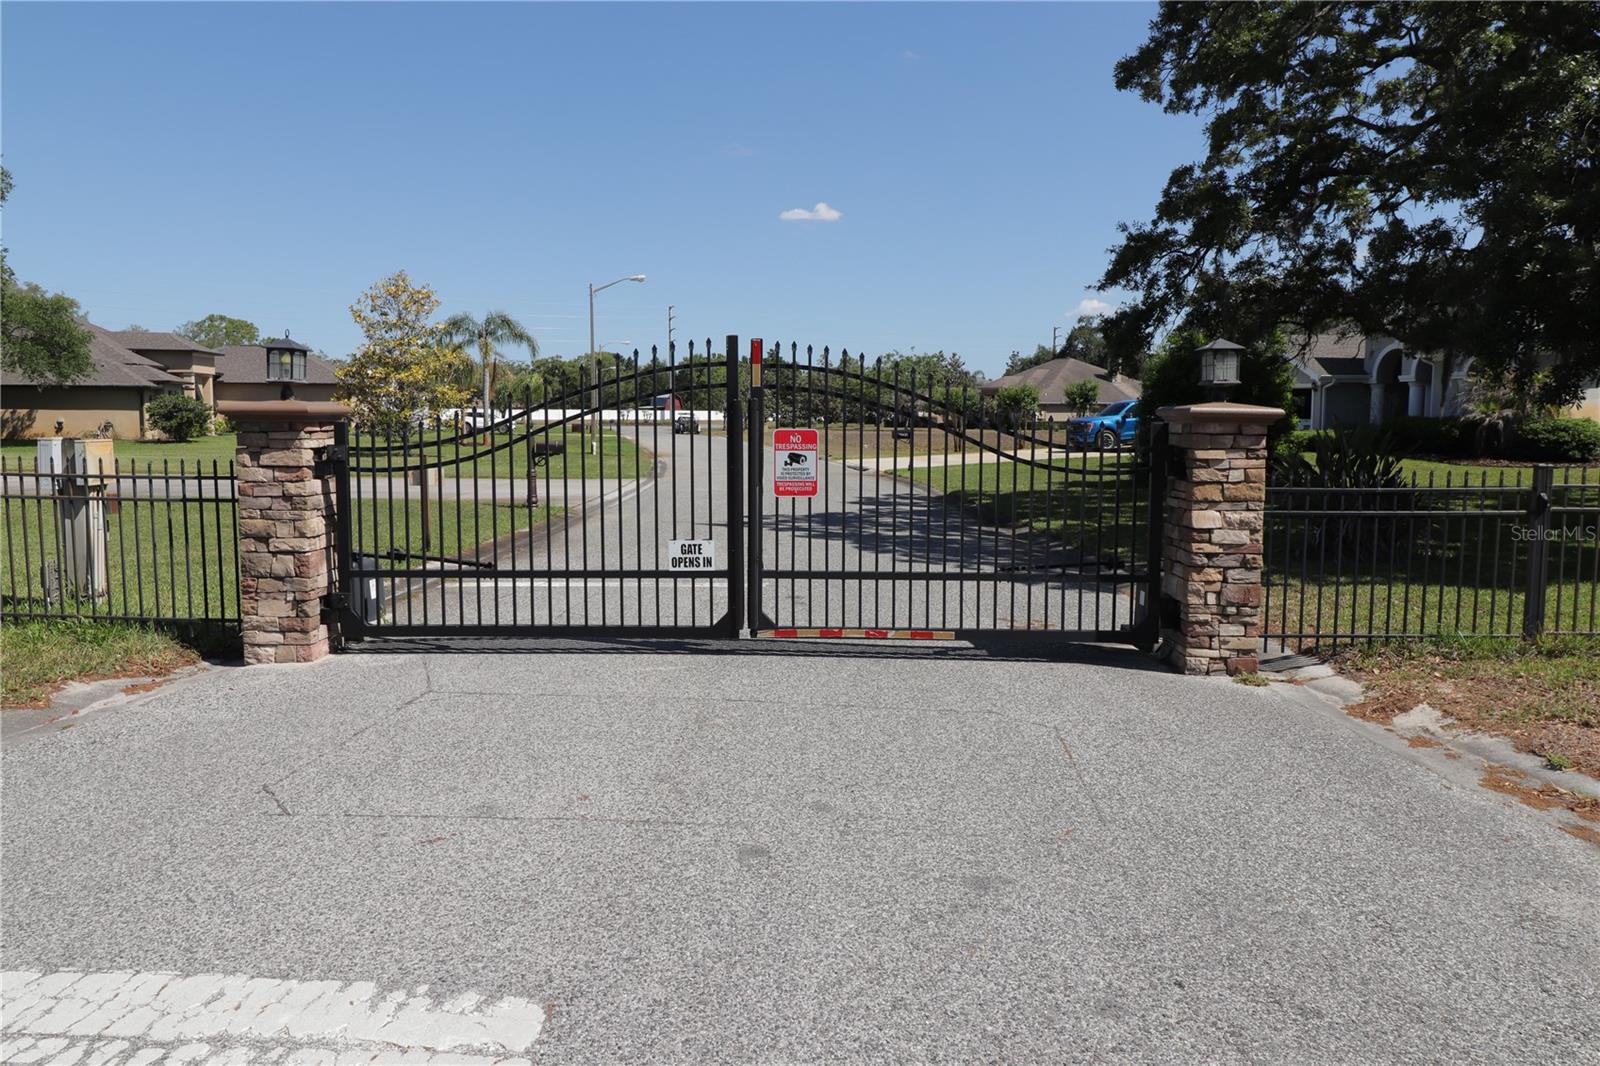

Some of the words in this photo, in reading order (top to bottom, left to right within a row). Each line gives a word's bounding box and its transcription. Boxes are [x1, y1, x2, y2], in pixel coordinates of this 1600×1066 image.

[790, 434, 802, 443] NO
[680, 543, 703, 555] GATE
[671, 556, 700, 568] OPENS
[702, 556, 713, 568] IN
